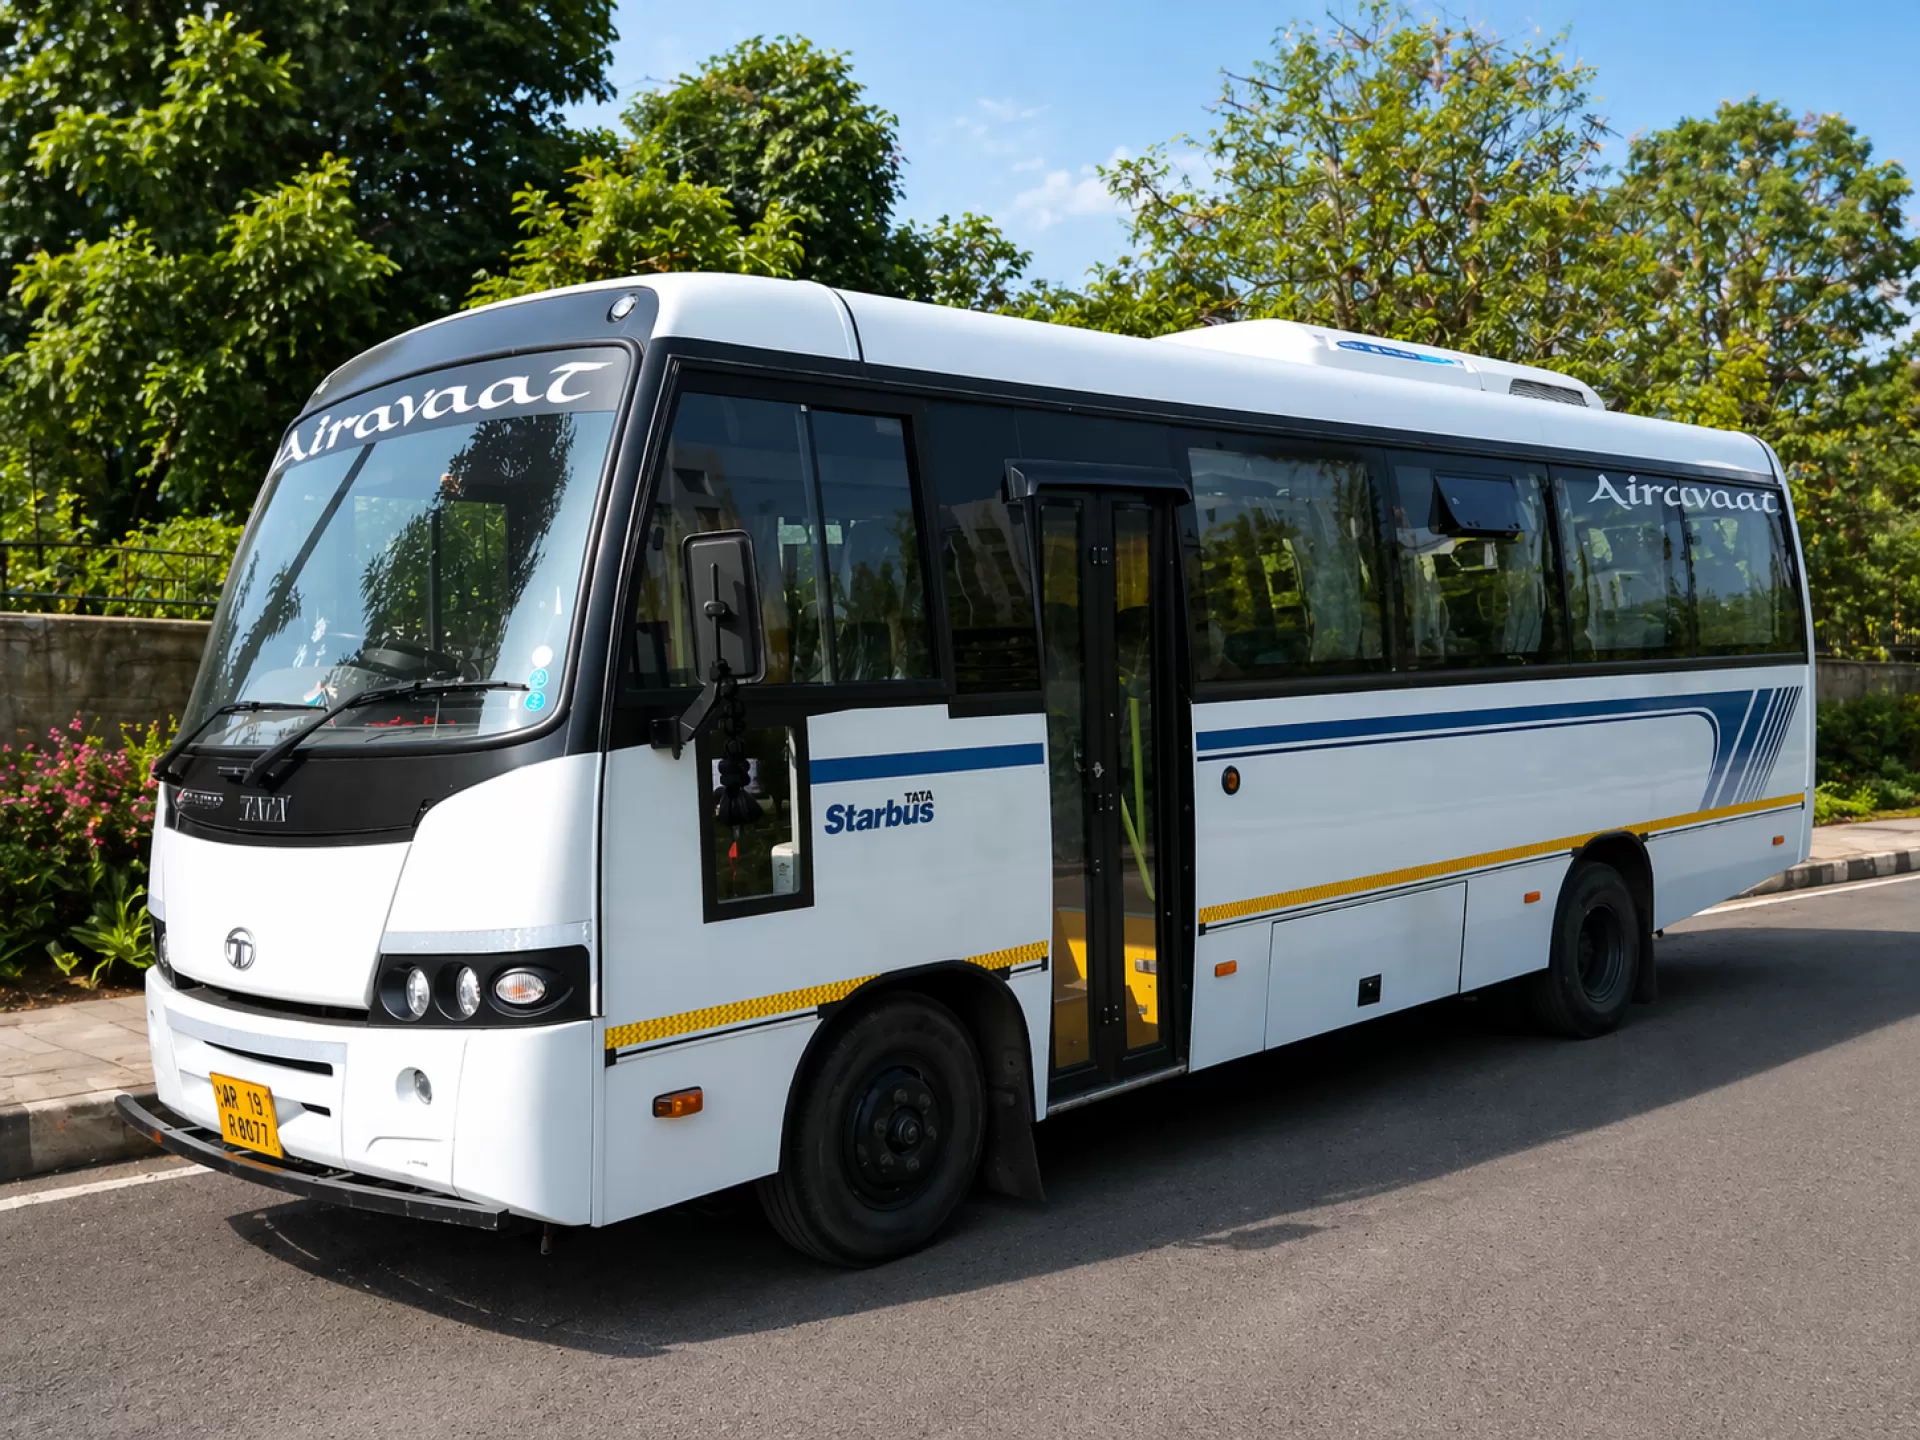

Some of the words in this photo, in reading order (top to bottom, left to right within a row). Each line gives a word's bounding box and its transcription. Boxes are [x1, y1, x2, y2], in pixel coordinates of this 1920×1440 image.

[904, 790, 934, 803] TATA
[824, 799, 935, 834] Starbus
[247, 1090, 263, 1116] 19
